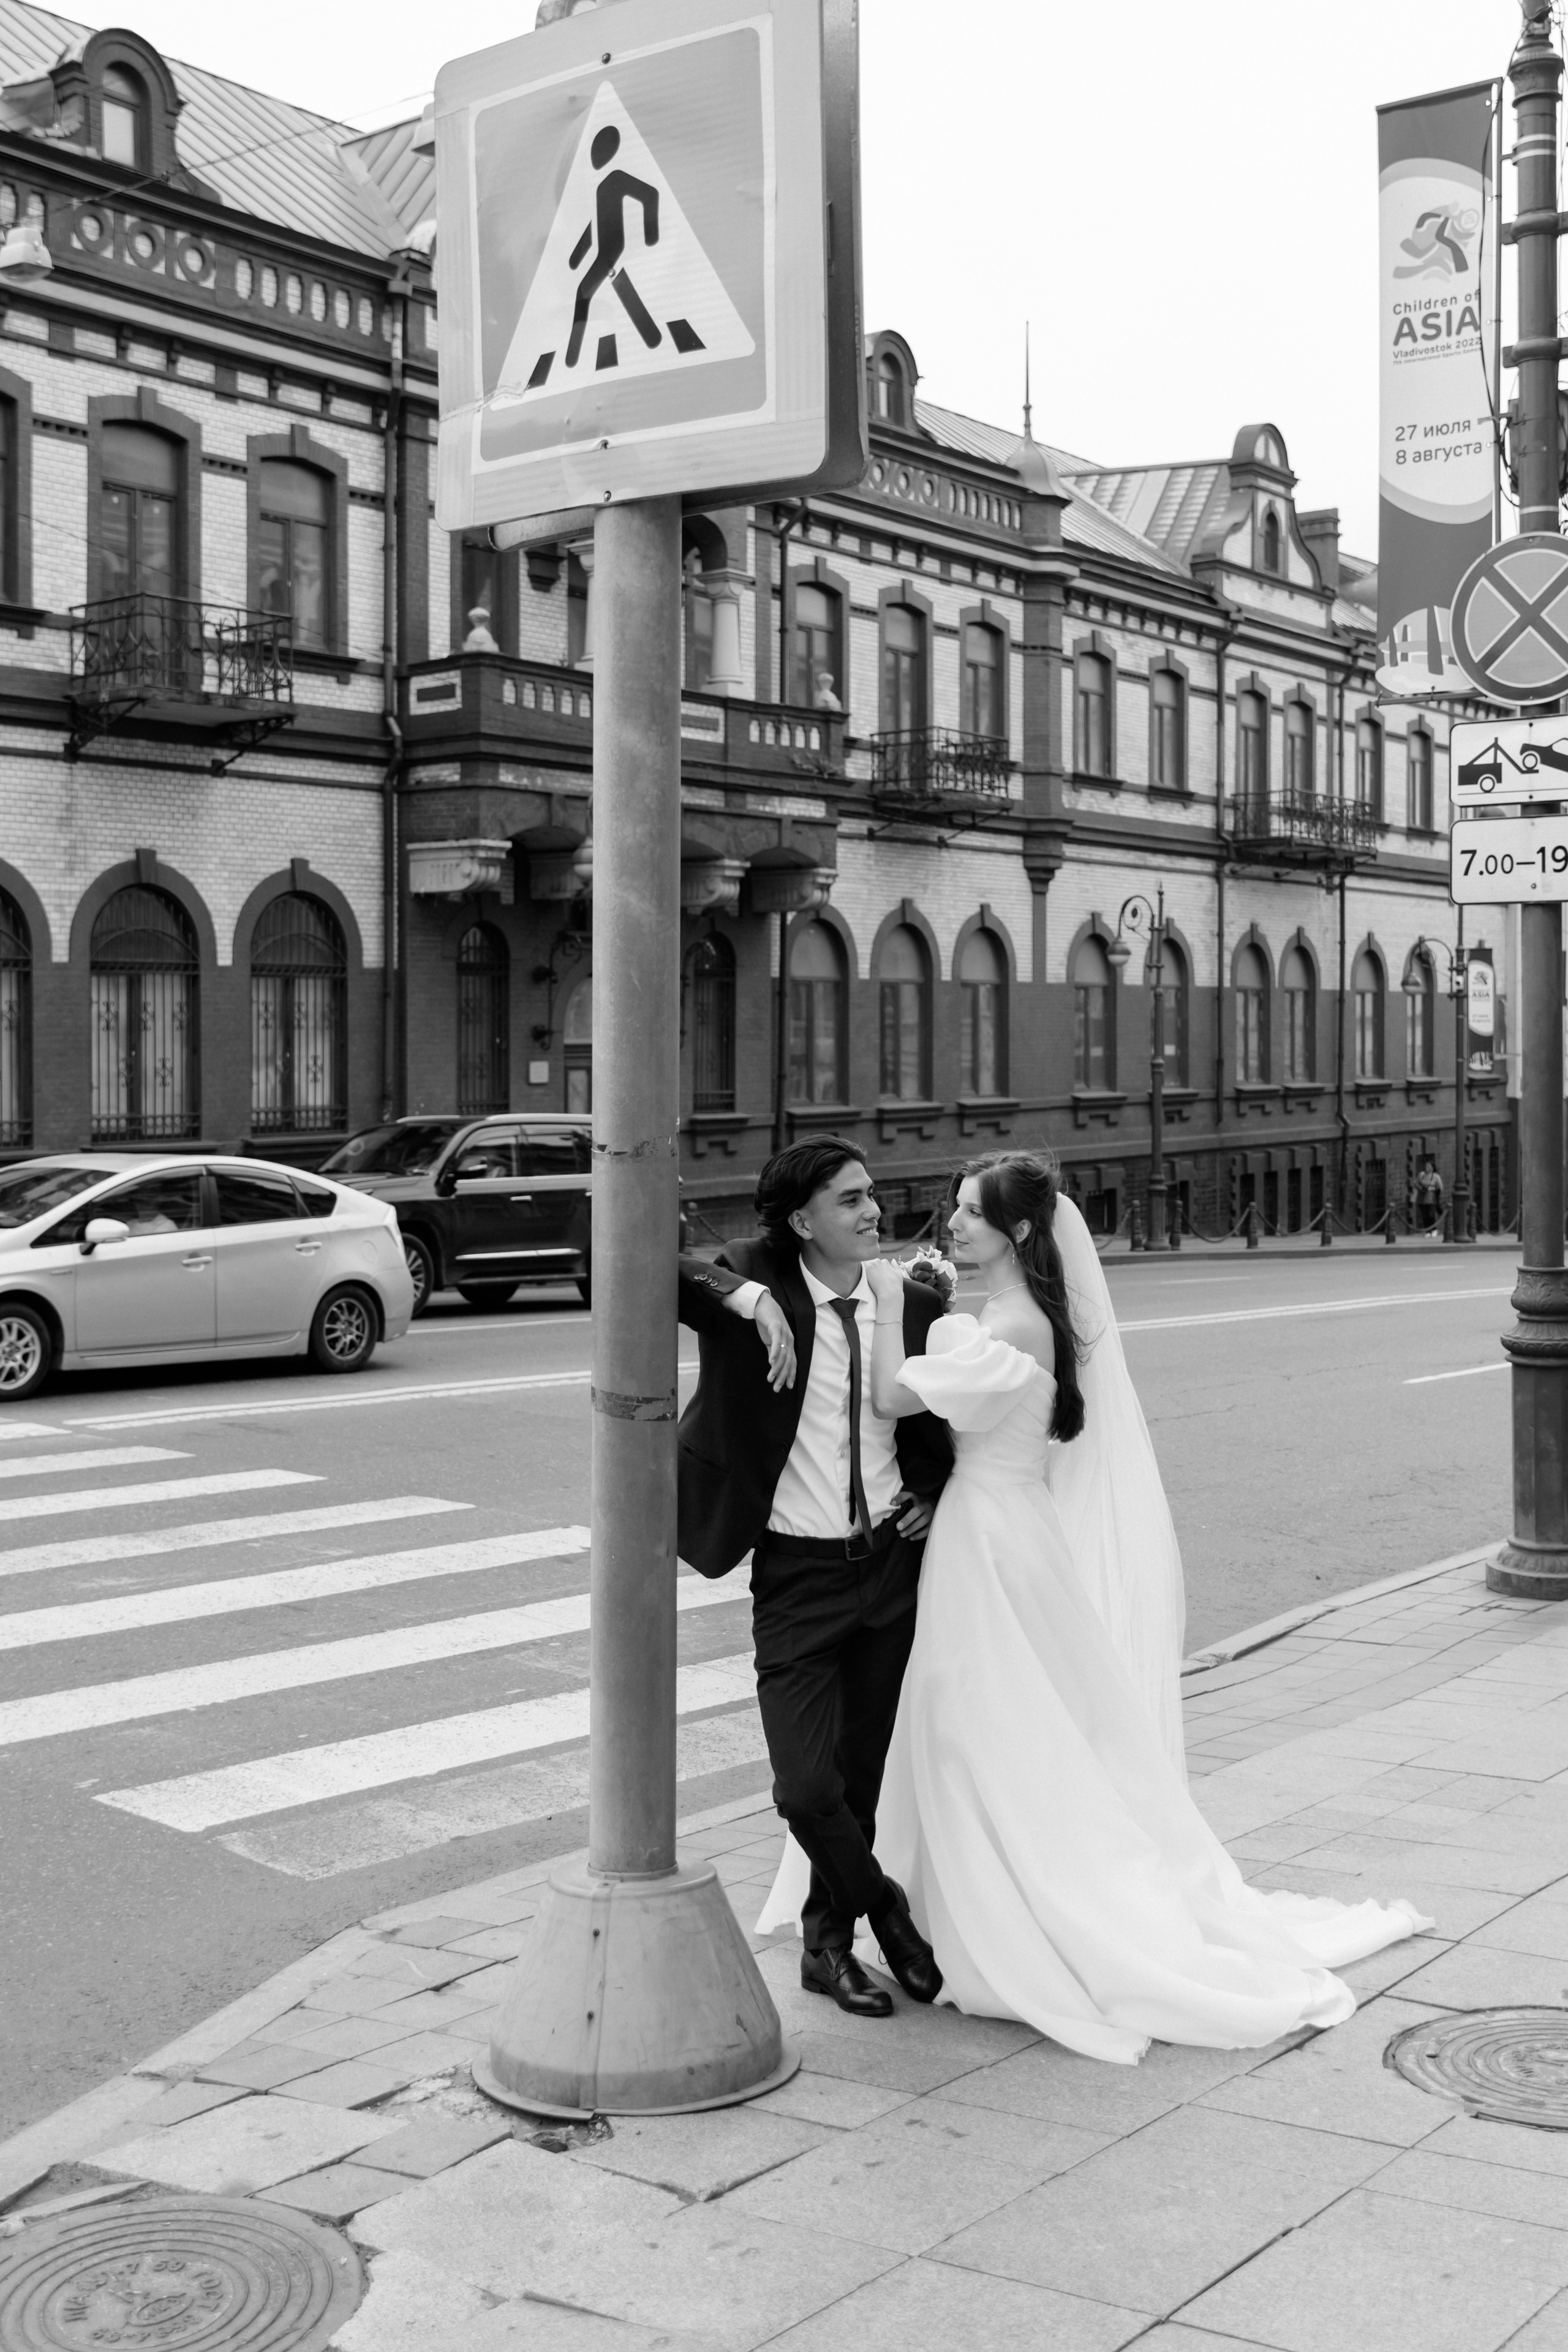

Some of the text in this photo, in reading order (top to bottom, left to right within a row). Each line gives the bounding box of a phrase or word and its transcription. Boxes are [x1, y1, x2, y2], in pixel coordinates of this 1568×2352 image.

[1393, 288, 1480, 315] Children of
[1393, 306, 1479, 346] ASIA
[1393, 337, 1482, 359] Vladivostok 2022
[1395, 420, 1471, 441] 27 июля
[1396, 442, 1482, 464] 8 августа
